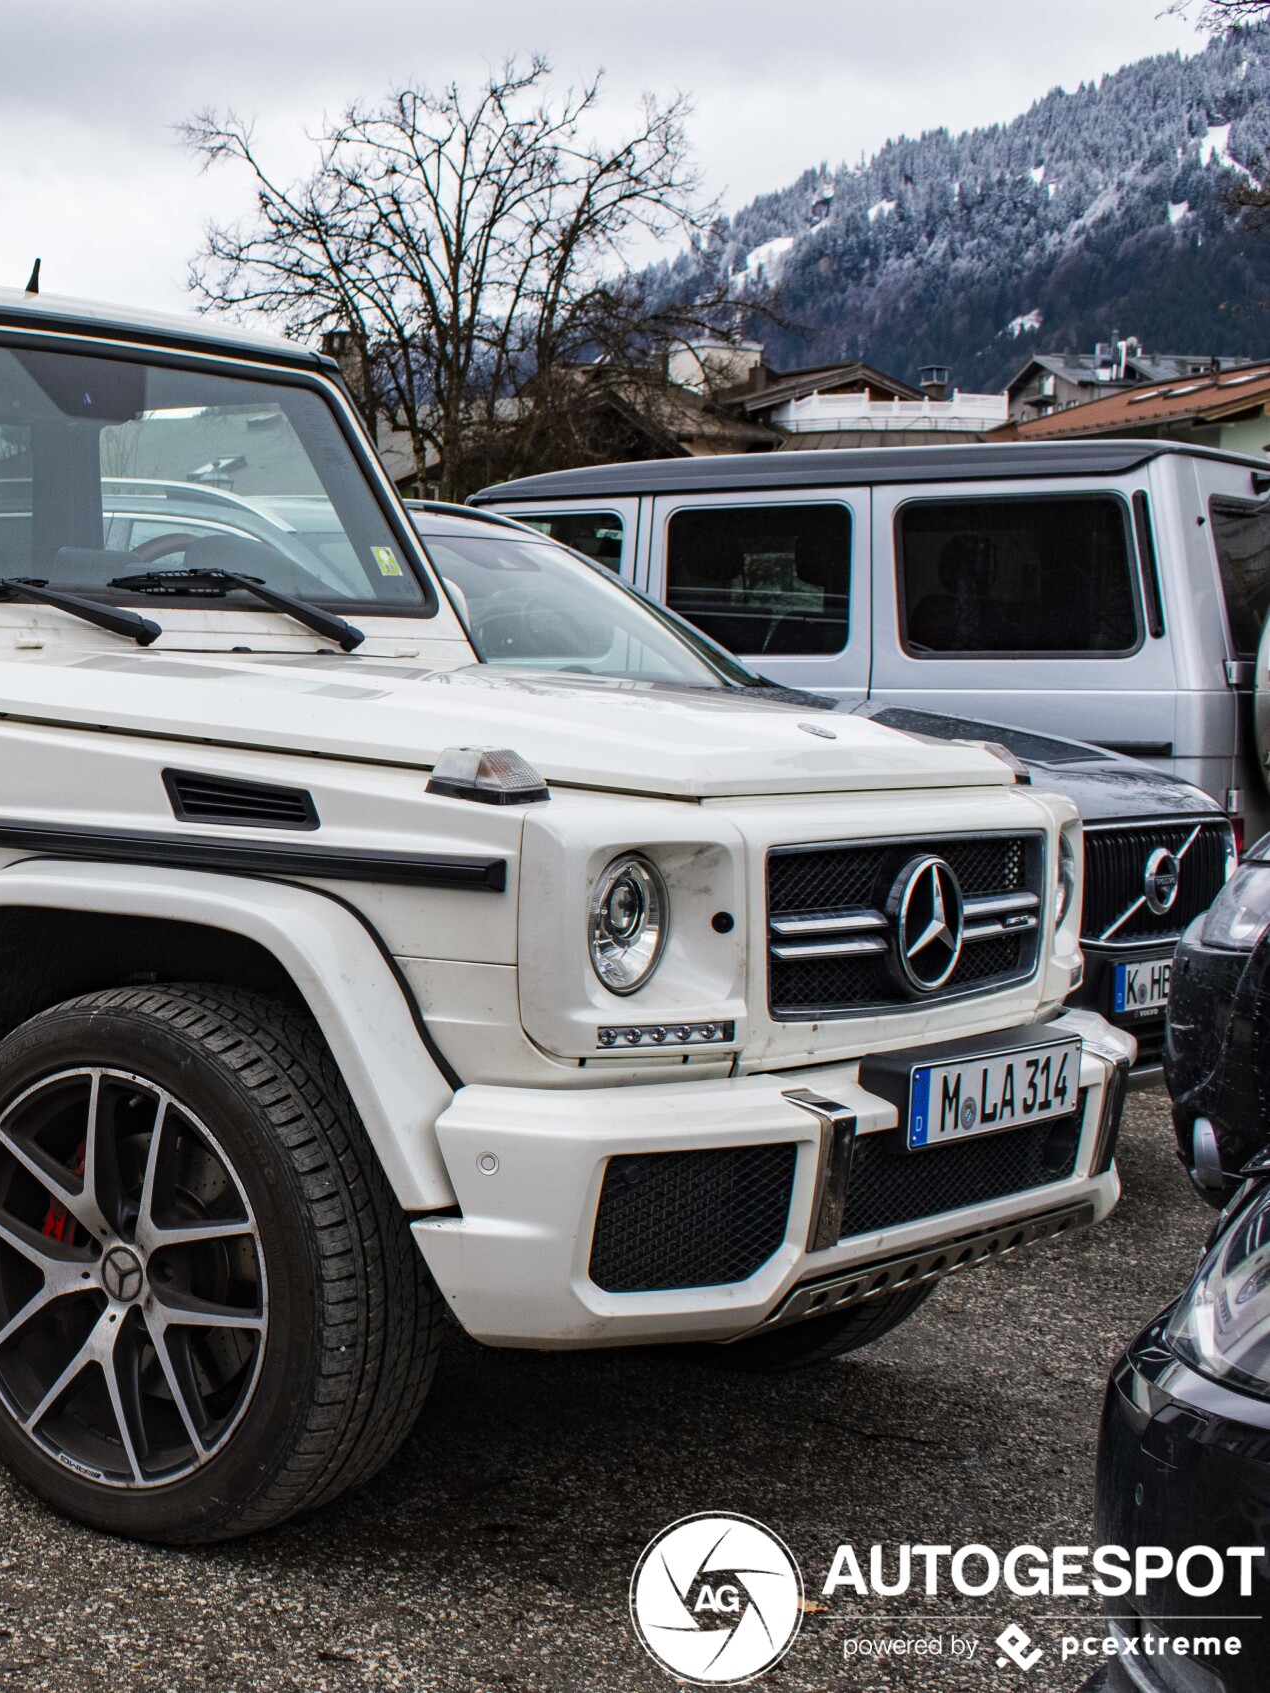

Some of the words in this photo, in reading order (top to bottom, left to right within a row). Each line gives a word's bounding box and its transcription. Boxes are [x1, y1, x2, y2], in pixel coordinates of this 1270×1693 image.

[1126, 968, 1139, 1004] K
[1139, 1008, 1159, 1017] VOLVO
[940, 1072, 961, 1132] M
[980, 1063, 1015, 1124] LA
[1022, 1052, 1069, 1114] 314
[915, 1115, 923, 1132] D
